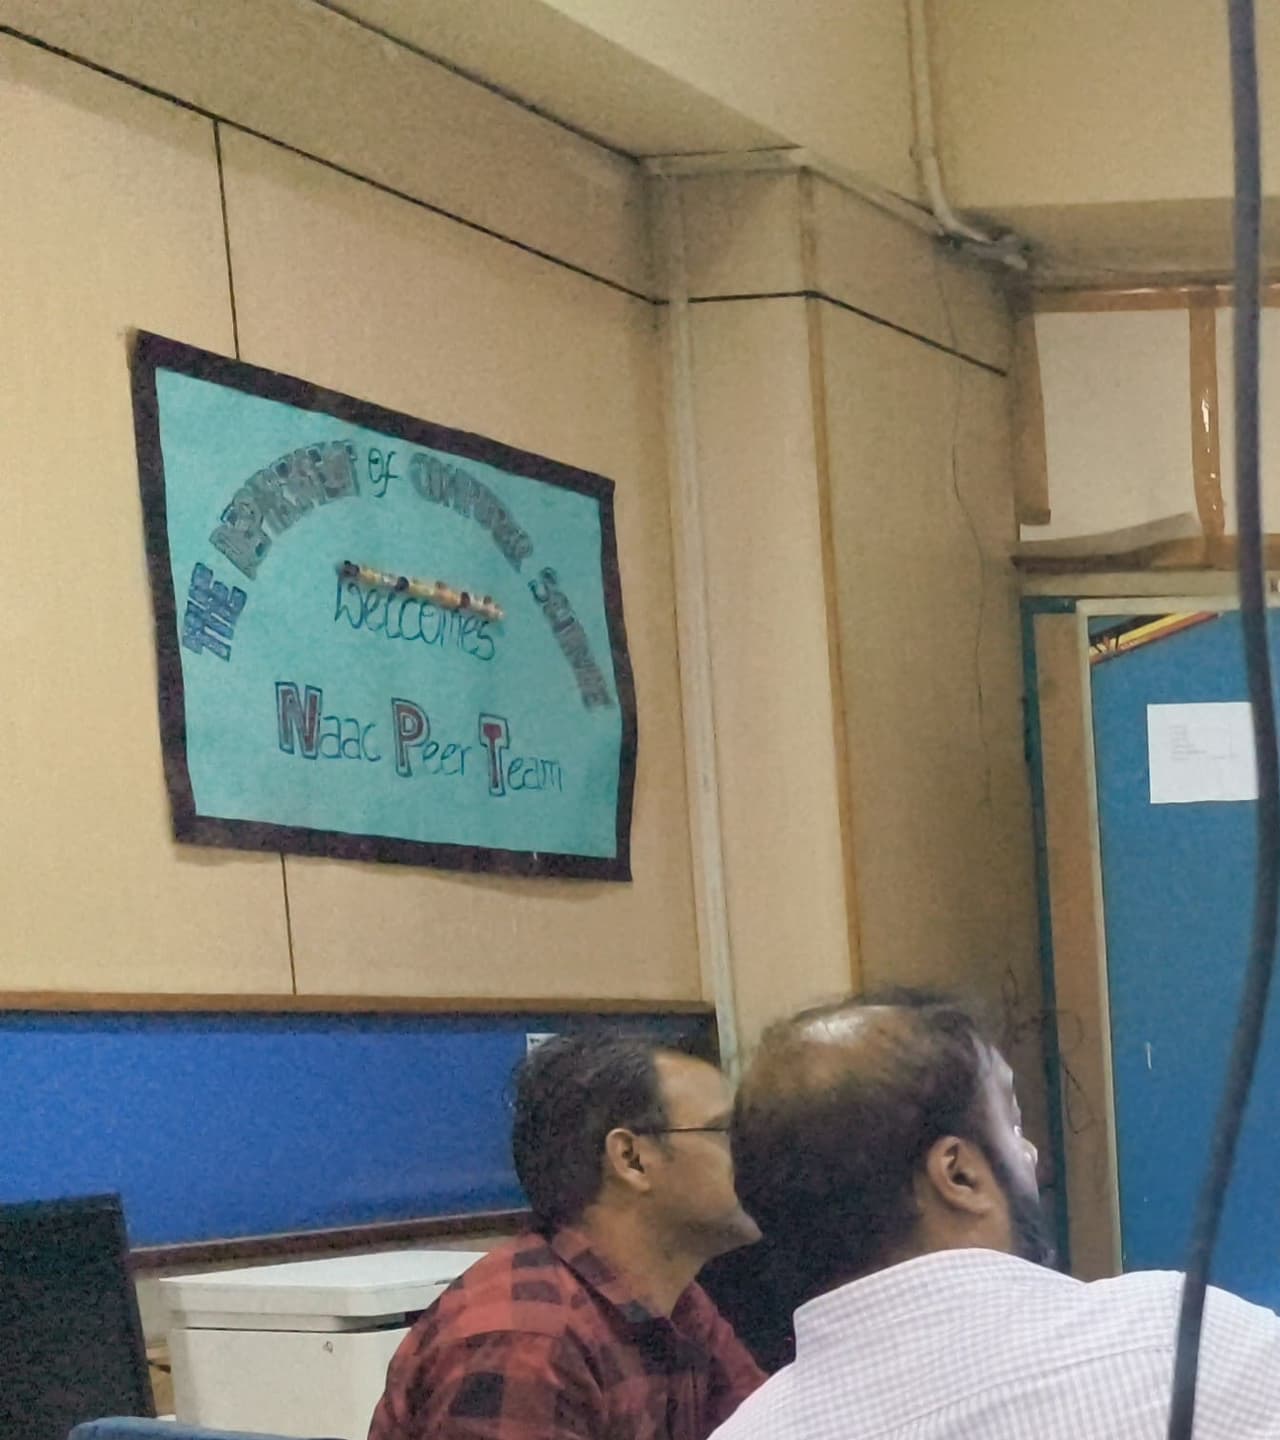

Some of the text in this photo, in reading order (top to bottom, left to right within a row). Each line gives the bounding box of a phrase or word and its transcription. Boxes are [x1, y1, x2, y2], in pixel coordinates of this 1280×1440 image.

[275, 681, 563, 797] Naac Peer Team
